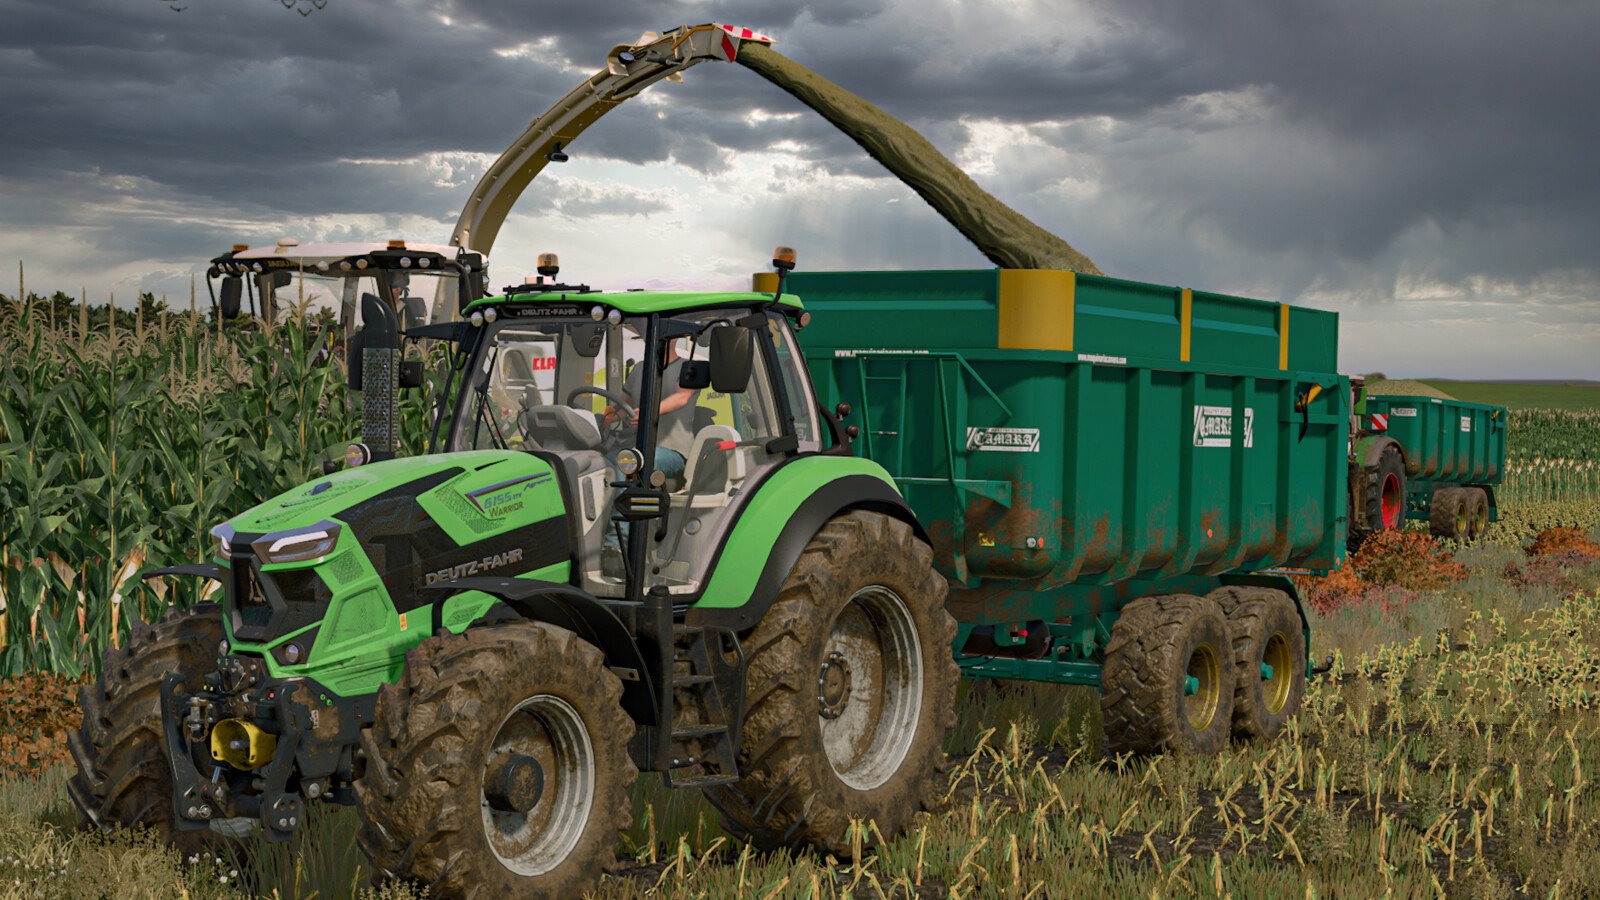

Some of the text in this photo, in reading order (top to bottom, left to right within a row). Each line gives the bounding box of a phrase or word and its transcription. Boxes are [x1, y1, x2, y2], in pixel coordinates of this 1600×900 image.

[521, 308, 577, 316] DEUTZ-FAHR
[974, 431, 1033, 446] CAMARA
[484, 491, 512, 509] 6155
[425, 548, 523, 586] DEUTZ-FAHR
